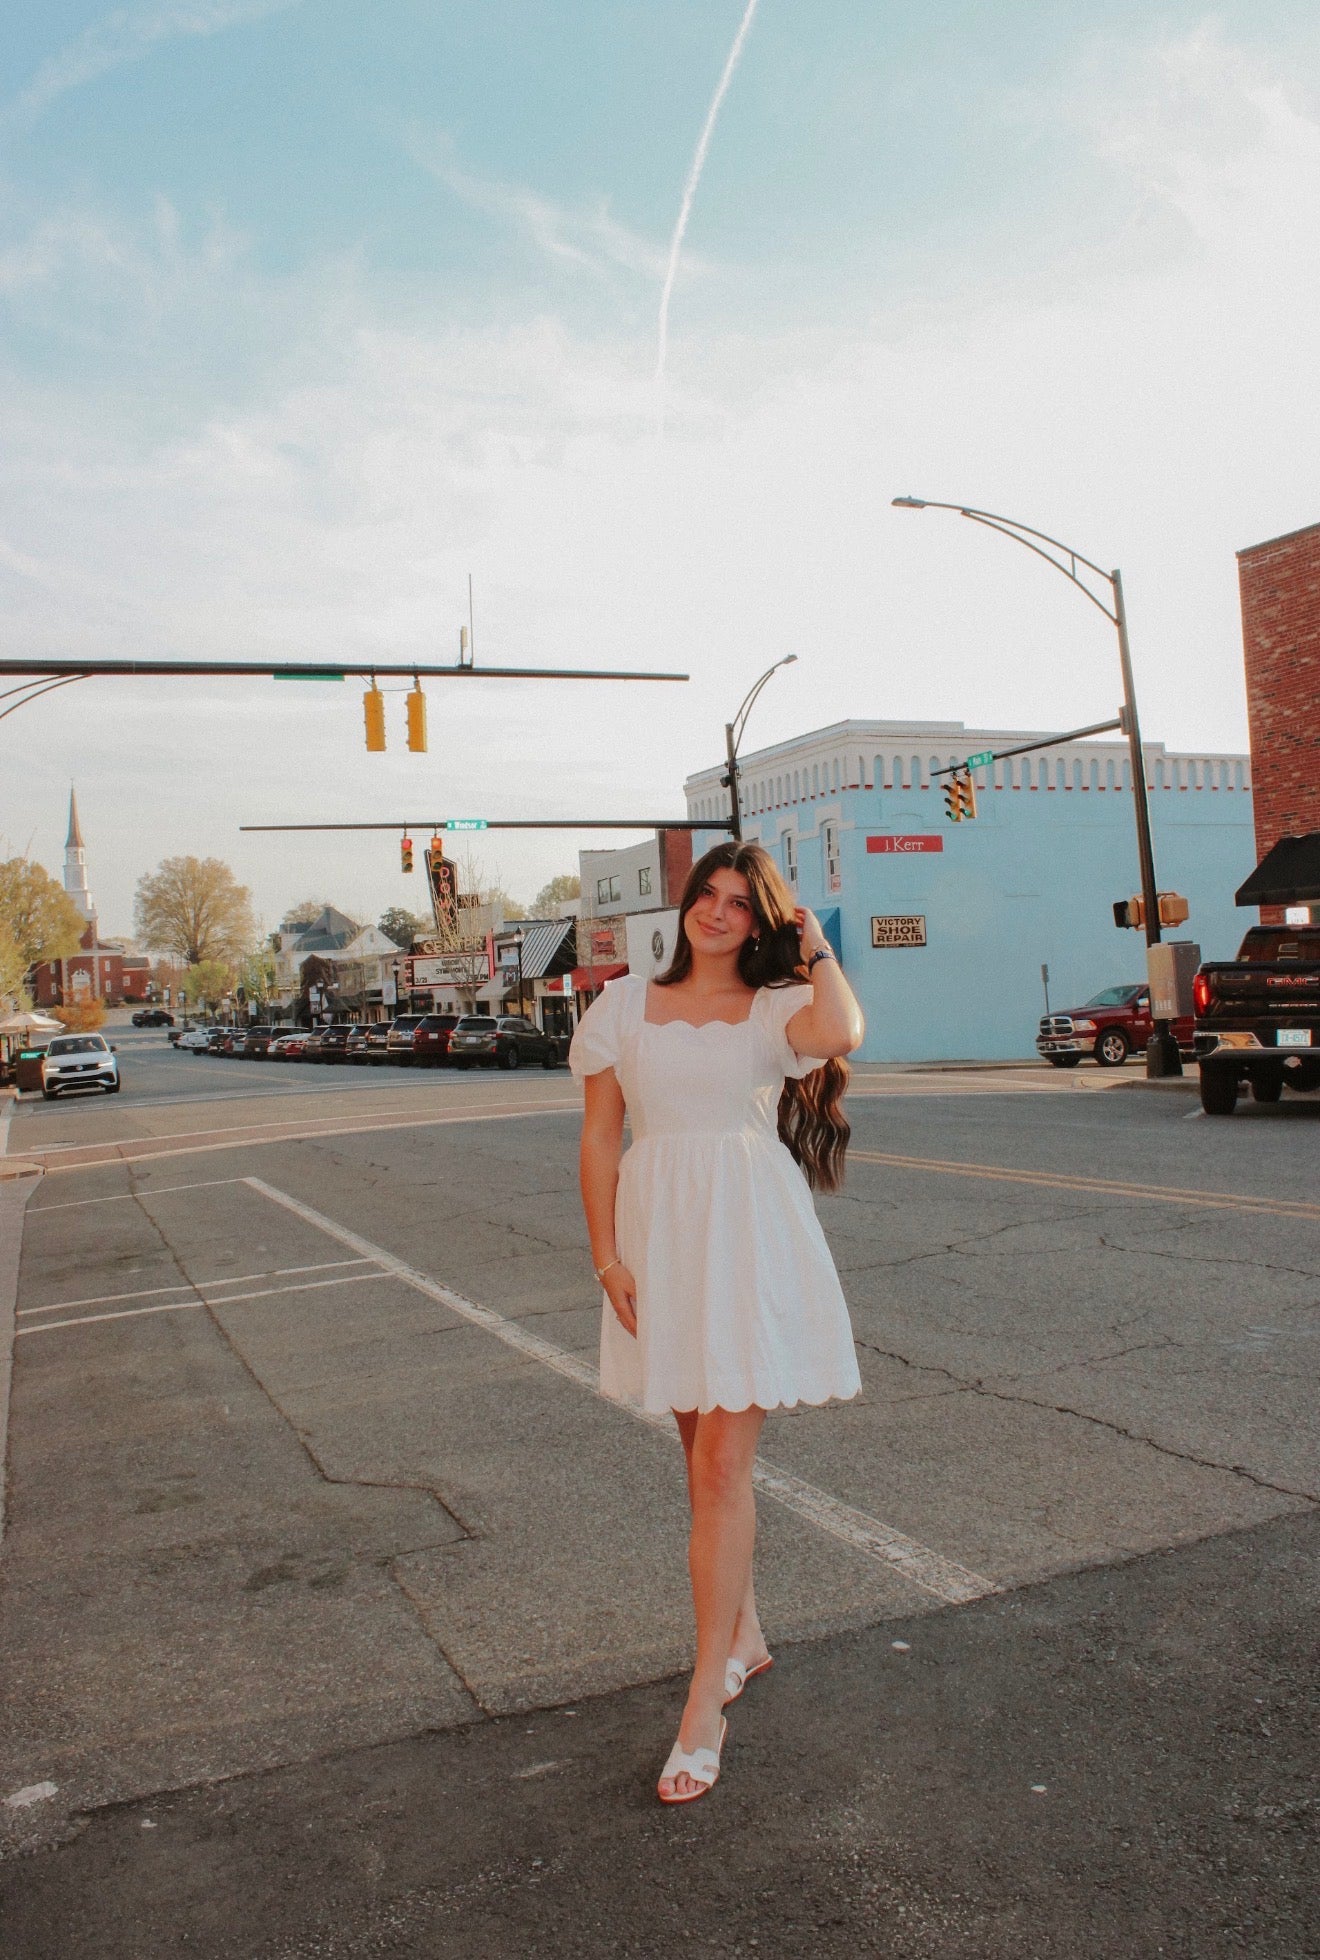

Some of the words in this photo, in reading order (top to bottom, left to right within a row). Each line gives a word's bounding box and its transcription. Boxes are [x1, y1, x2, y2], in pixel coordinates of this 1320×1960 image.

[893, 837, 924, 851] Kerr
[878, 926, 921, 934] SHOE
[1267, 977, 1319, 986] GMC
